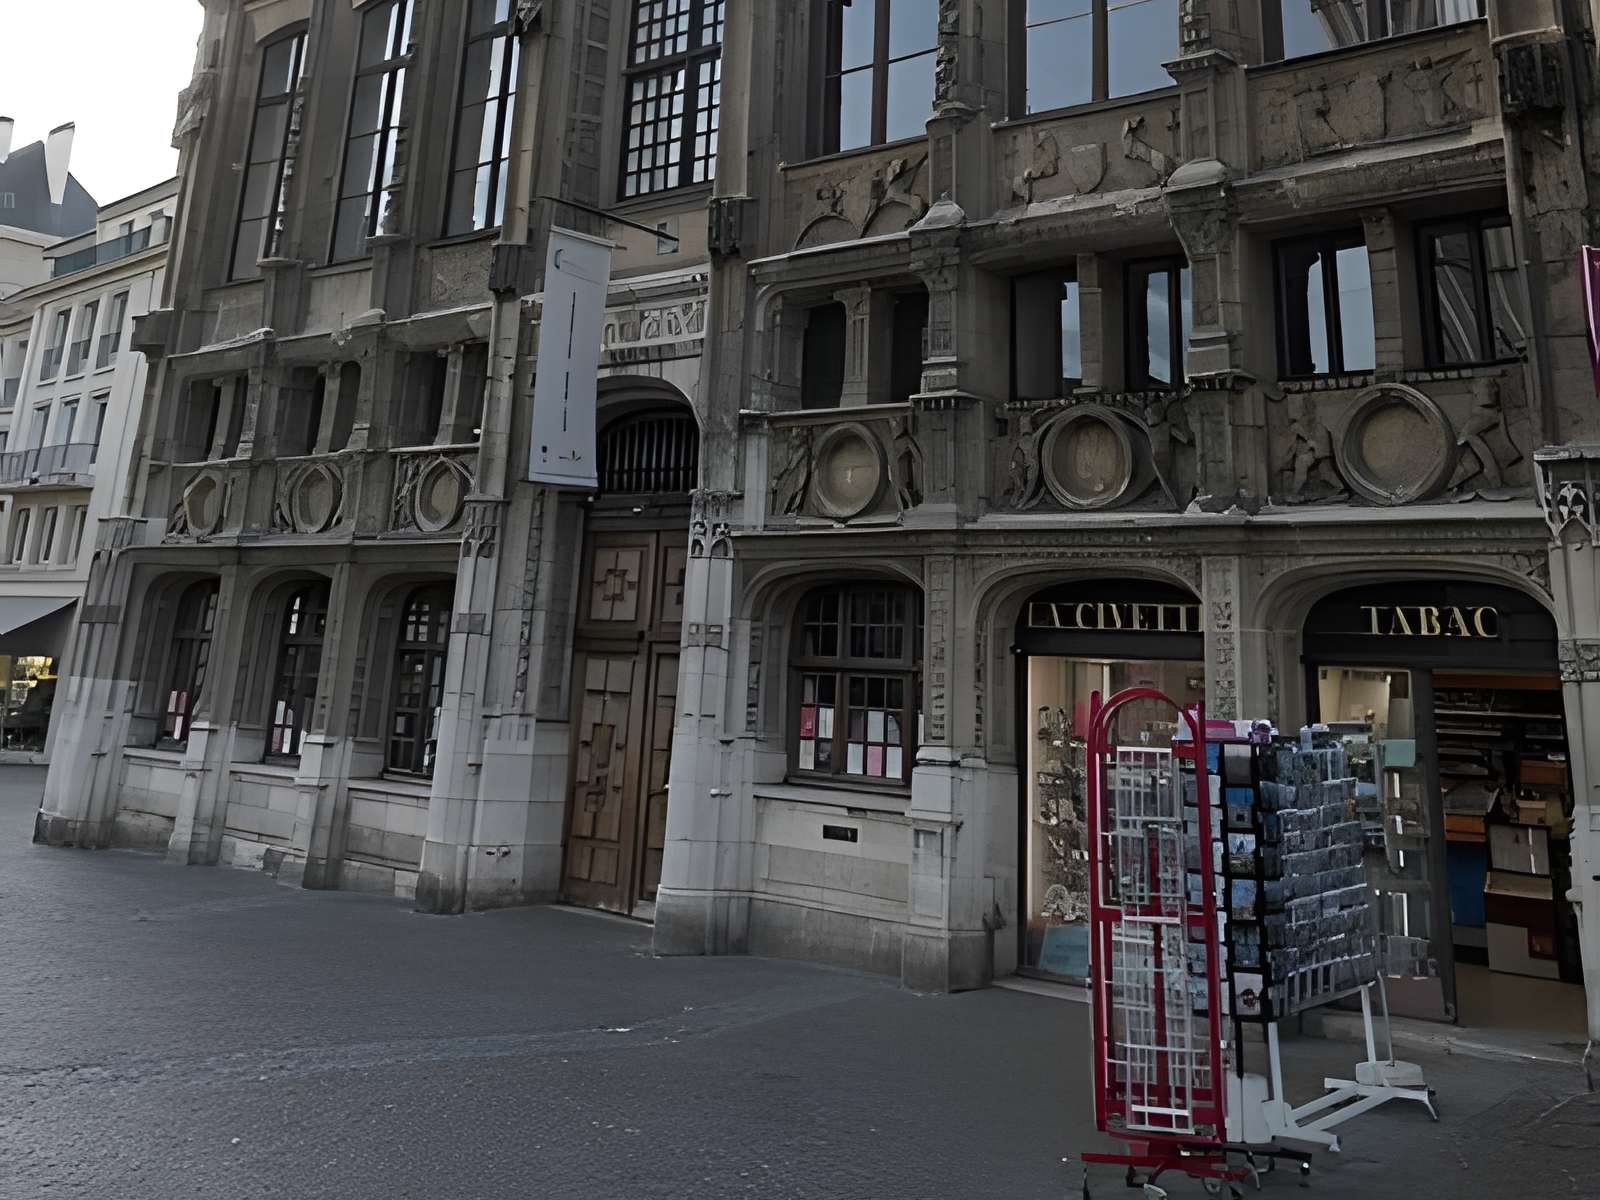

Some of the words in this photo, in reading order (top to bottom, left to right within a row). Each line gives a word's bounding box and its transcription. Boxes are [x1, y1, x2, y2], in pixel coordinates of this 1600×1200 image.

[1027, 602, 1062, 628] LA
[1075, 602, 1203, 632] CIVETT
[1360, 605, 1499, 637] TABAC
